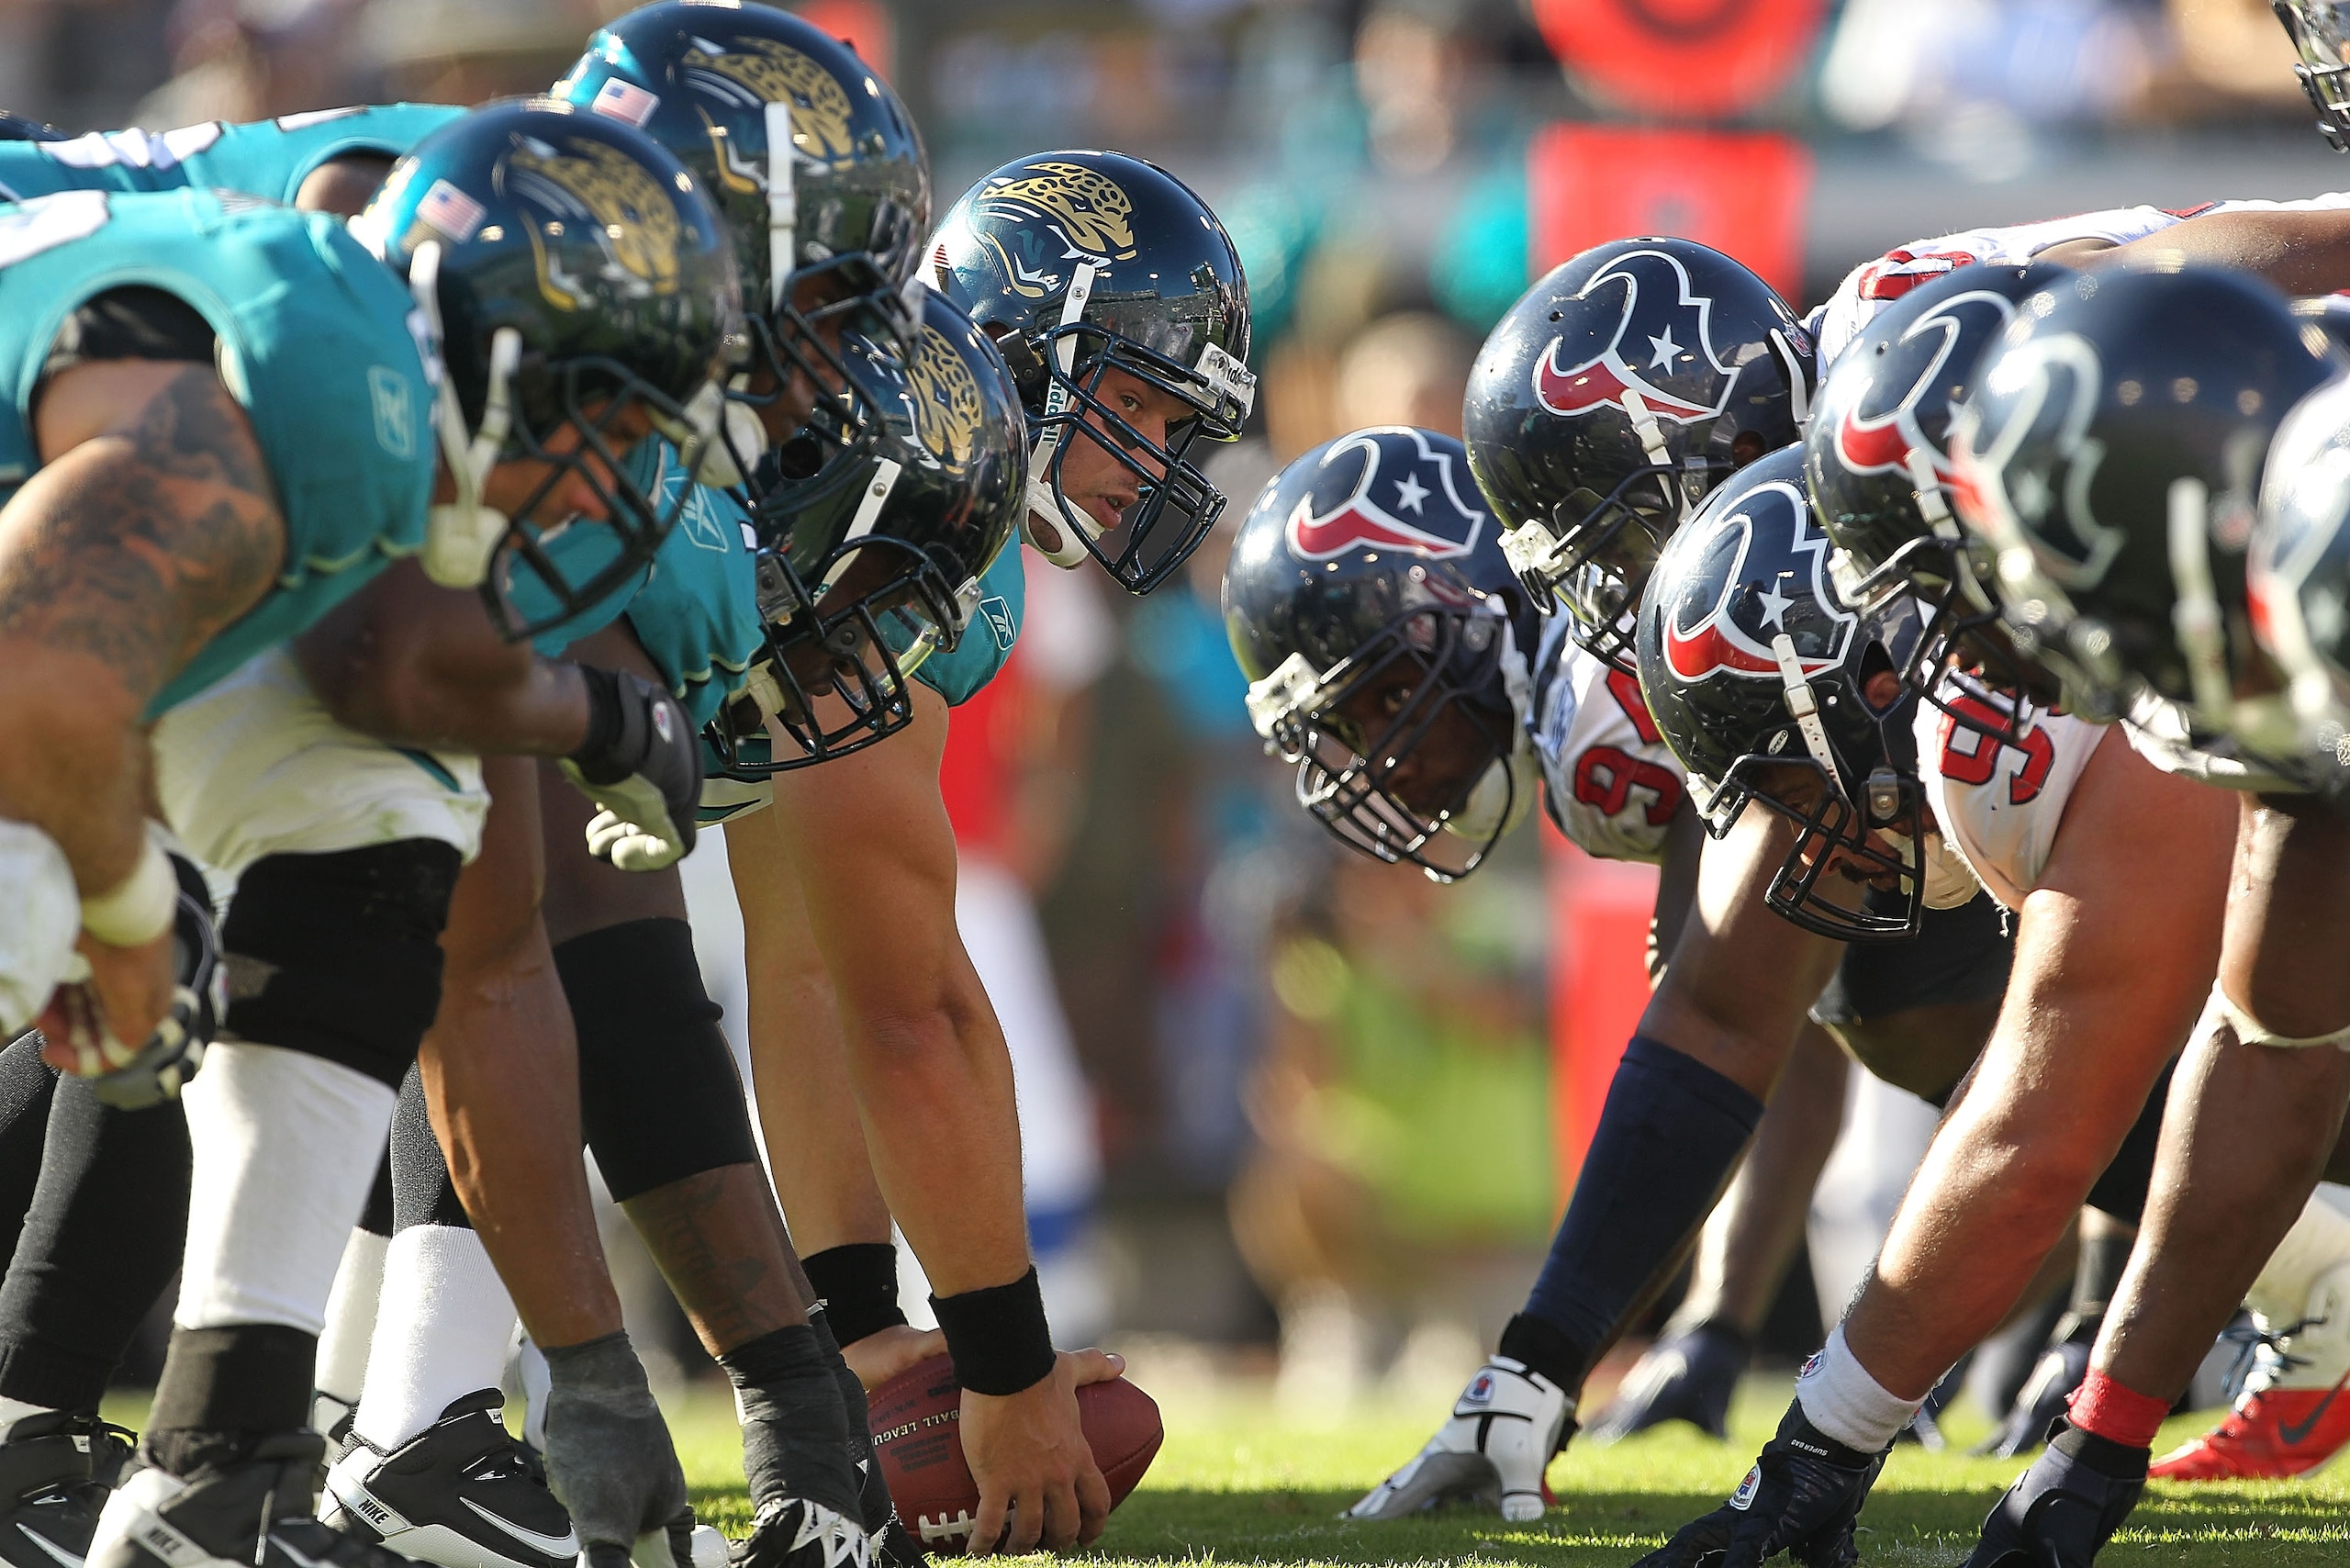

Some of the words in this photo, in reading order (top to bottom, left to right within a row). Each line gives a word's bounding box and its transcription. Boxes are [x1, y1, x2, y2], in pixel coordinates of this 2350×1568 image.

[922, 1409, 961, 1428] BALL
[870, 1421, 919, 1446] LEAGU
[1790, 1439, 1806, 1449] BAD
[1803, 1443, 1829, 1457] SUPER
[357, 1497, 390, 1525] NIKE
